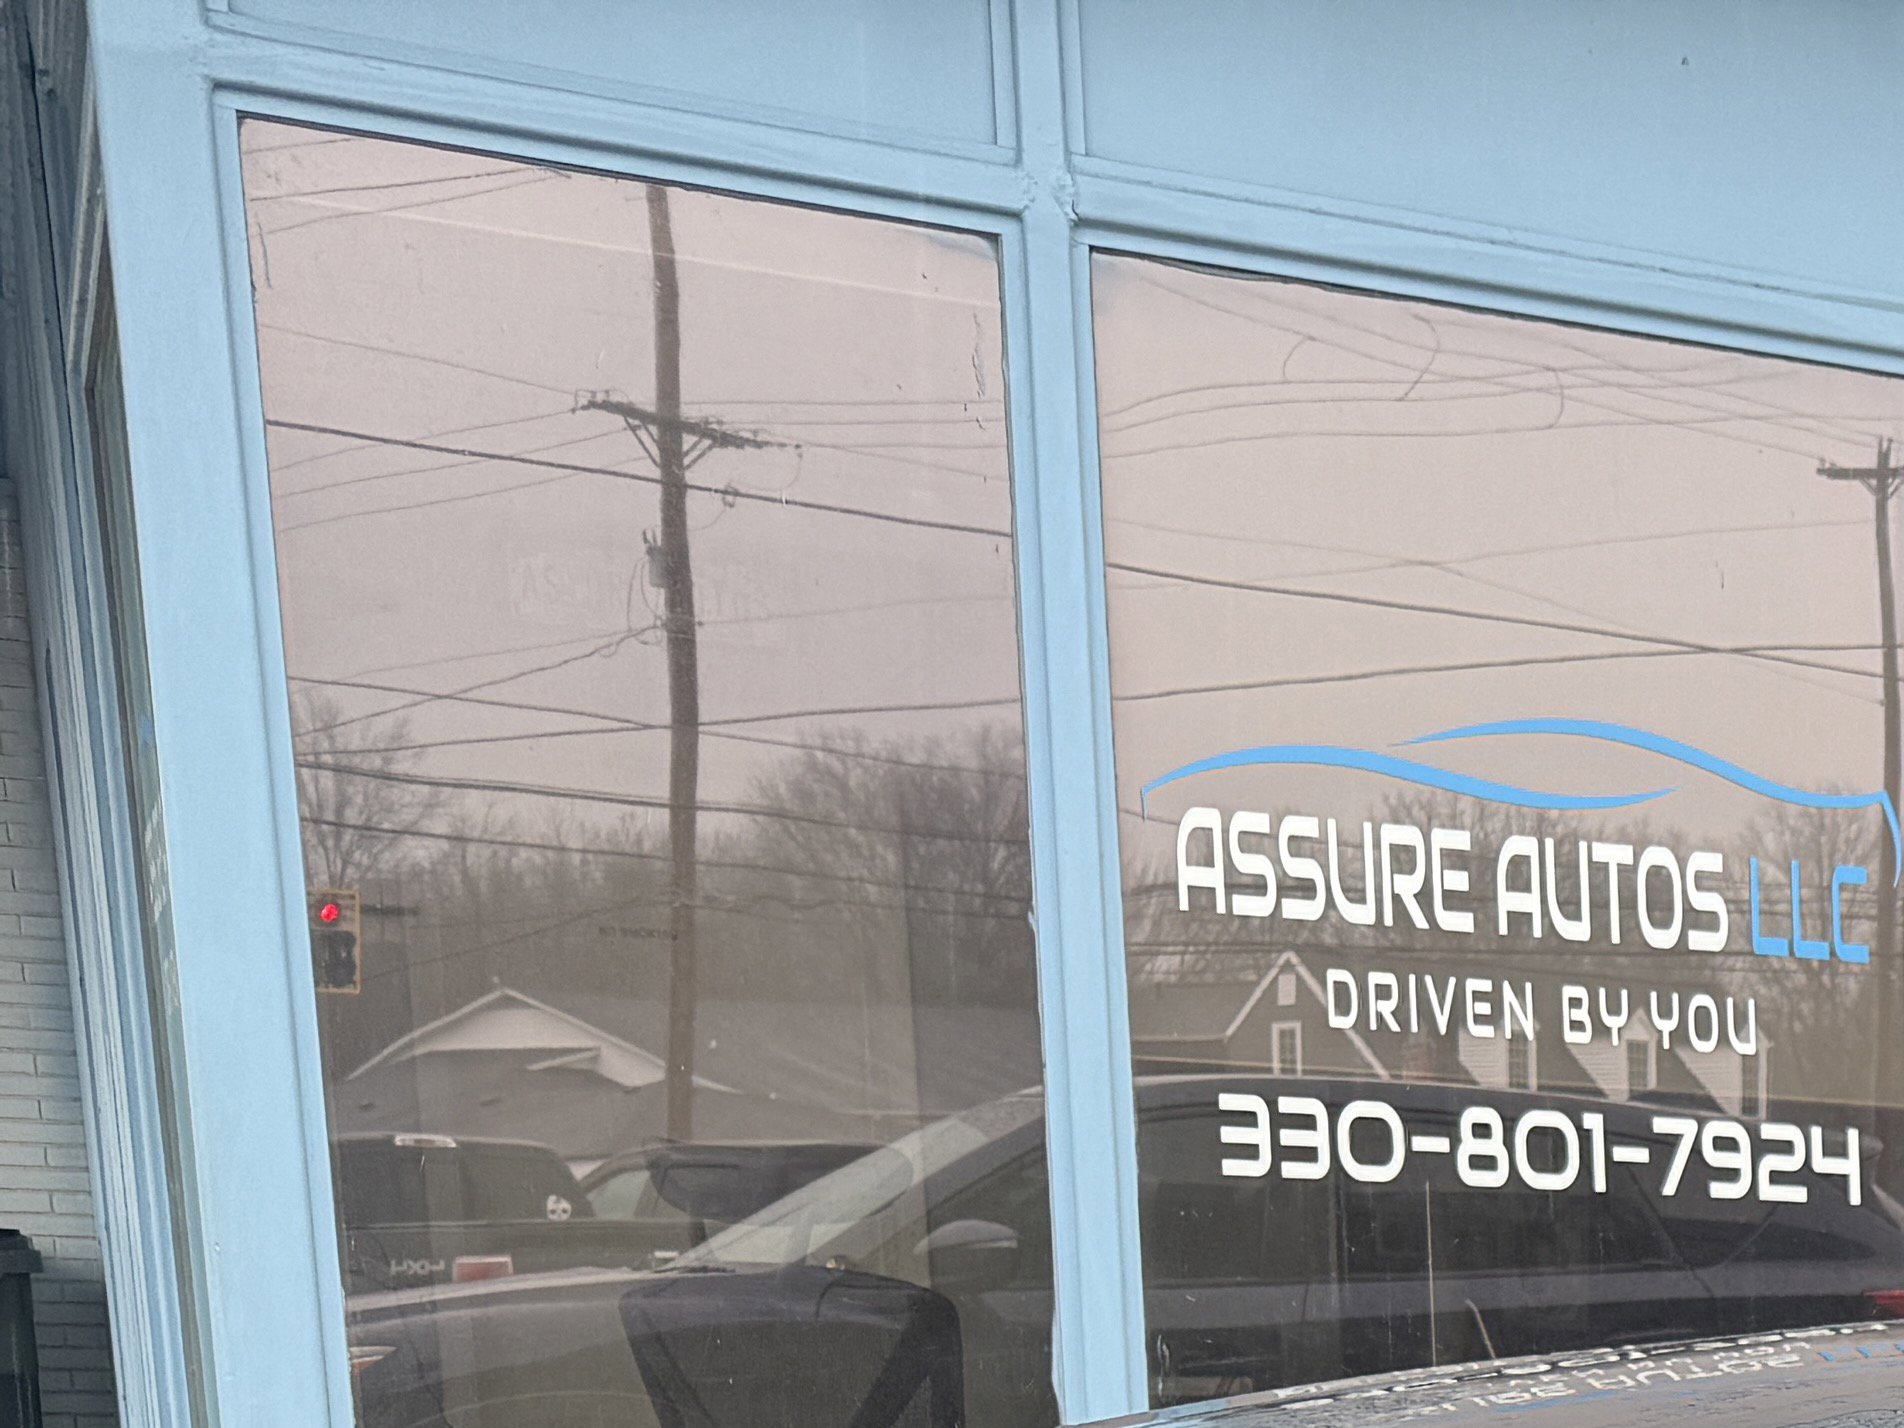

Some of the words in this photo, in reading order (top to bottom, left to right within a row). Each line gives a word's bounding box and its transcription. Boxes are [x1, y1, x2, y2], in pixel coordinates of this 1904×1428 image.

[1175, 806, 1476, 934] ASSURE
[1496, 833, 1730, 953] AUTOS
[1748, 856, 1871, 964] LLC
[1325, 968, 1536, 1041] DRIVEN
[1561, 984, 1630, 1047] BY
[1649, 990, 1759, 1056] YOU
[1217, 1092, 1863, 1207] 330-801-7924
